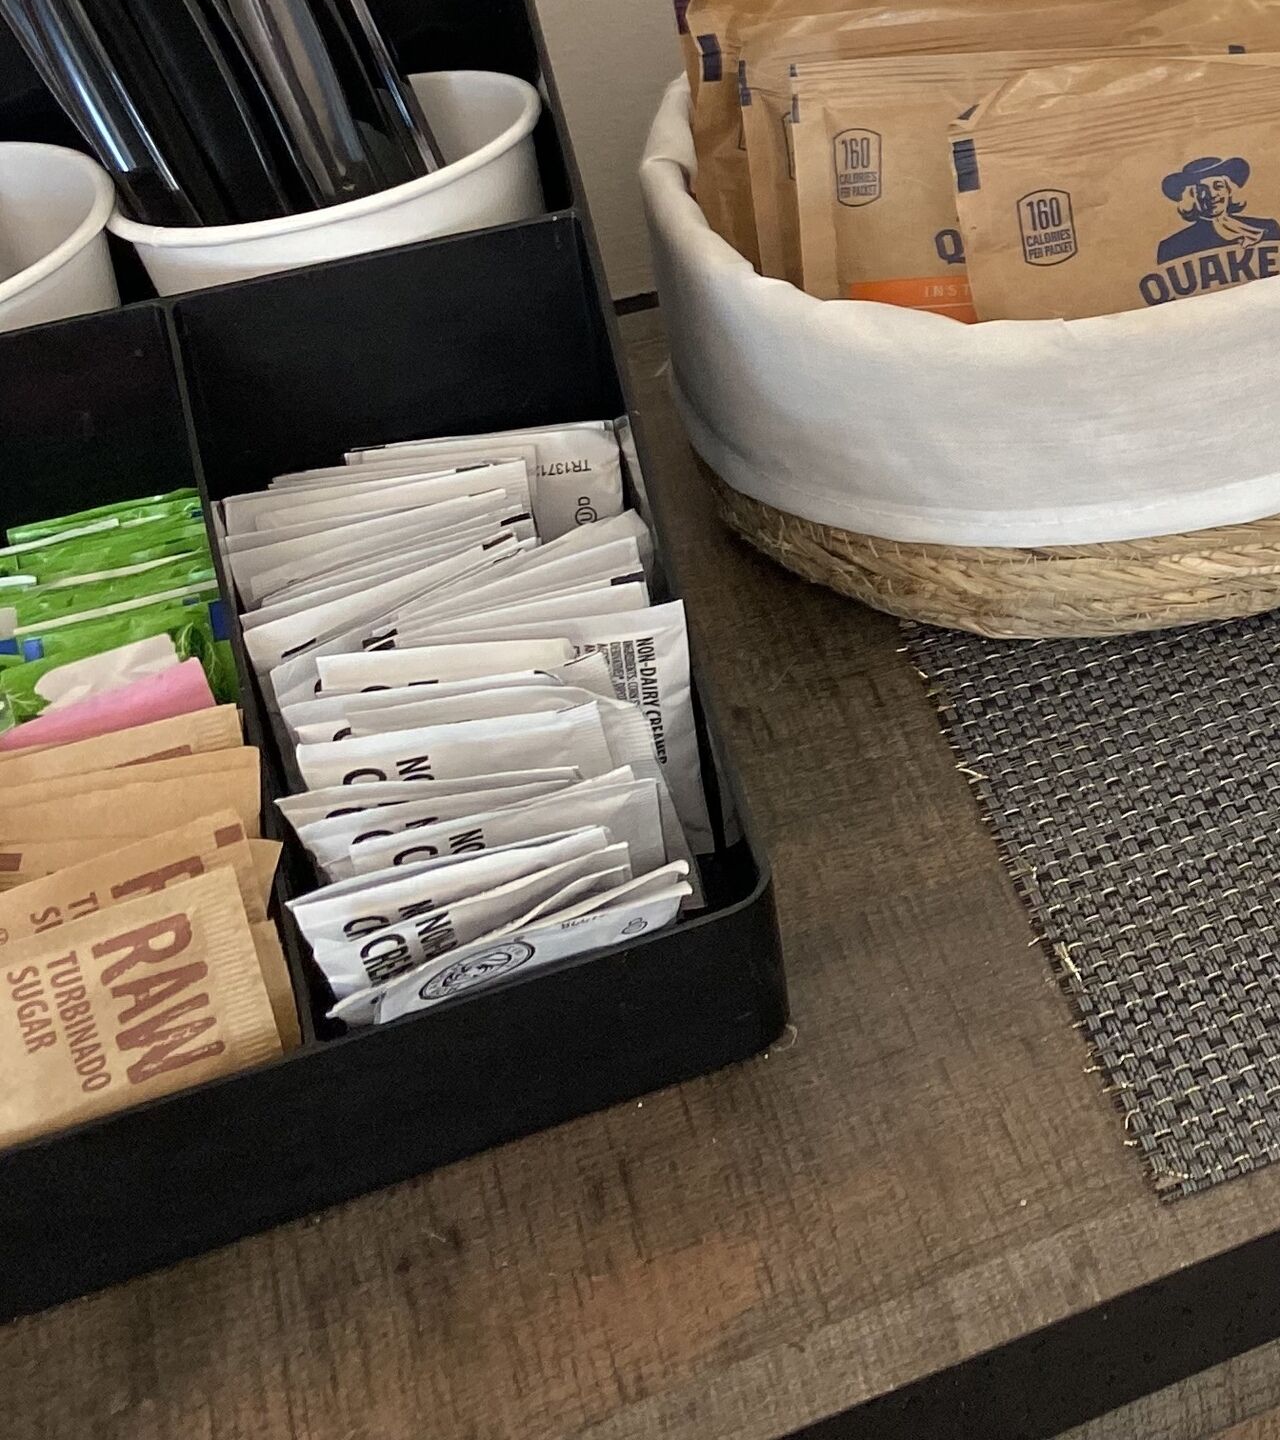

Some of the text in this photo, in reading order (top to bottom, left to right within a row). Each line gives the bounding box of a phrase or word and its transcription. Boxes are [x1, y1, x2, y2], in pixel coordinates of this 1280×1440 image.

[841, 137, 871, 170] 160
[839, 171, 878, 185] CALORIES
[855, 184, 877, 197] PACKET
[1026, 197, 1062, 231] 160
[1026, 229, 1071, 247] CALORIES
[1028, 243, 1073, 260] PER PACKET
[537, 459, 592, 477] TR1371
[636, 637, 660, 708] NON-DAIRY
[6, 965, 58, 1055] SUGAR
[91, 912, 226, 1085] RAW
[47, 950, 112, 1093] TURBINADO
